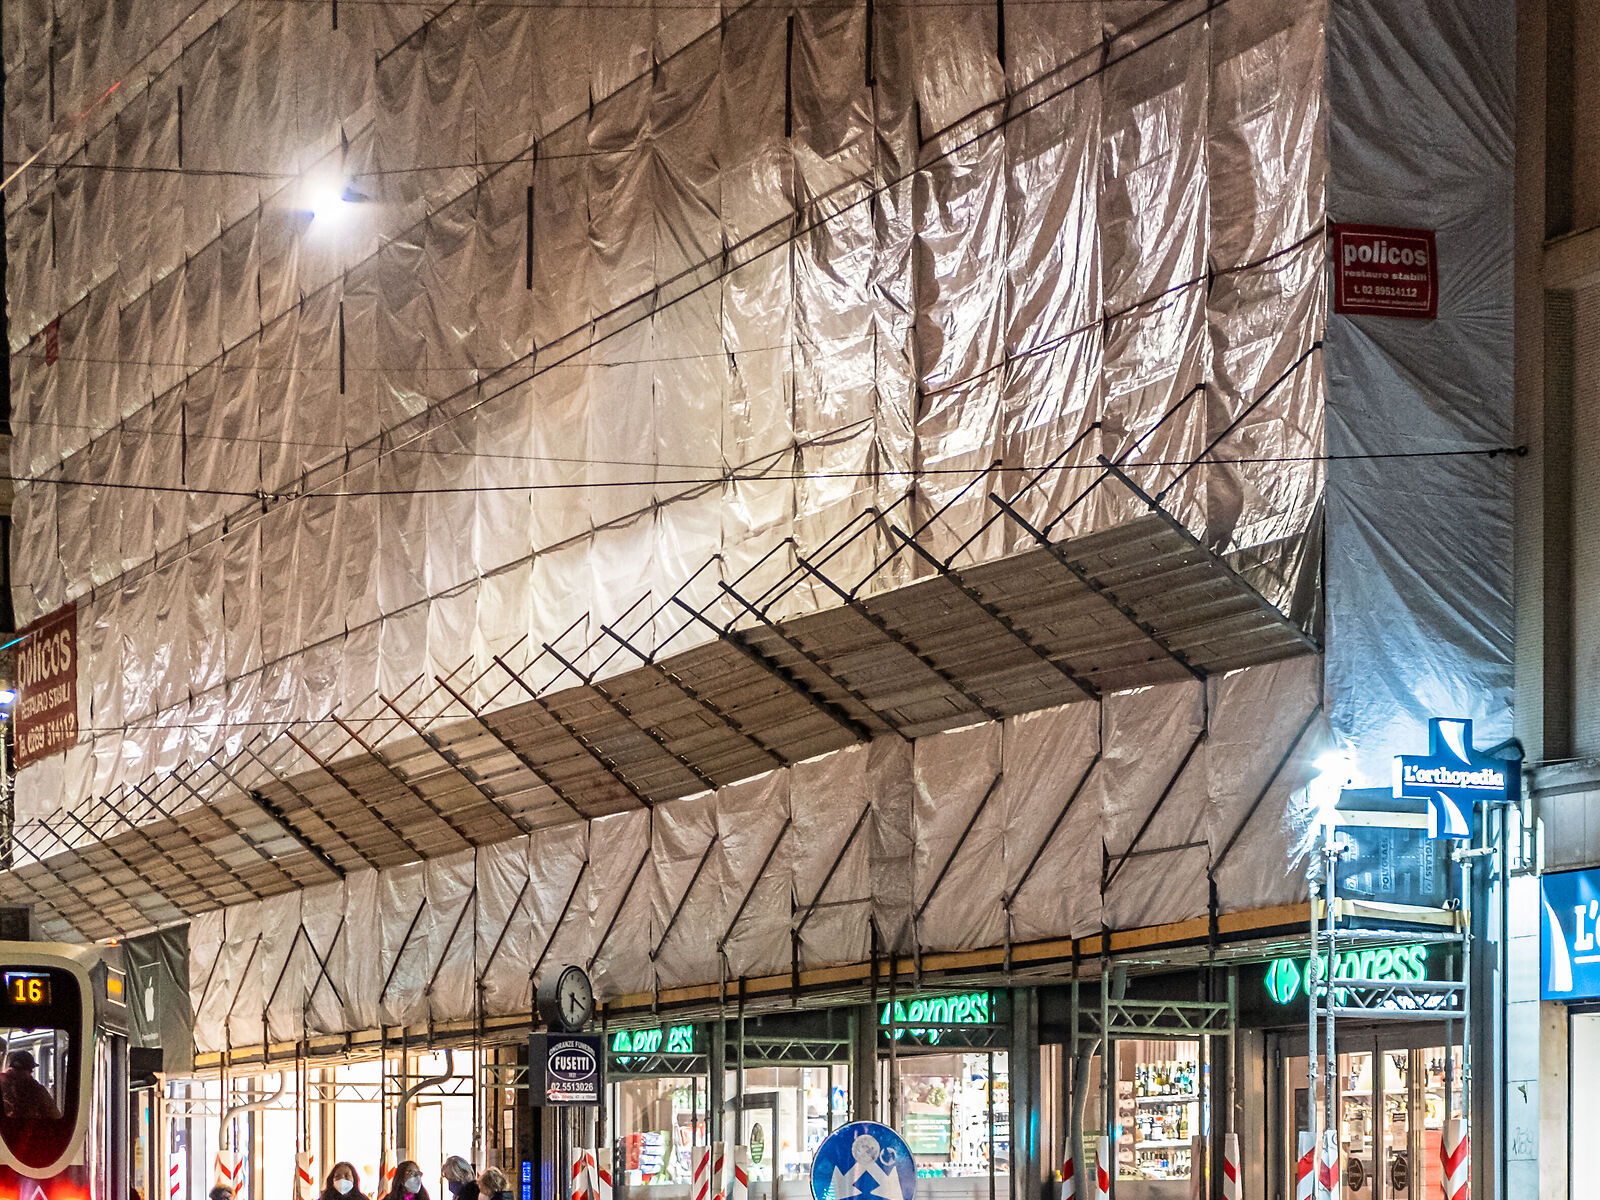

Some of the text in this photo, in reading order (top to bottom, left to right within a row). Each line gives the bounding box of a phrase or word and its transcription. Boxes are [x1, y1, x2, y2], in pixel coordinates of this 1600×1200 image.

[1344, 241, 1427, 267] policos
[1344, 270, 1427, 281] restauro stabili
[1362, 285, 1373, 295] 02
[18, 629, 71, 692] policos
[1403, 764, 1505, 789] L'orthopedia
[15, 978, 42, 1003] 16
[555, 1056, 590, 1070] FUSETTI
